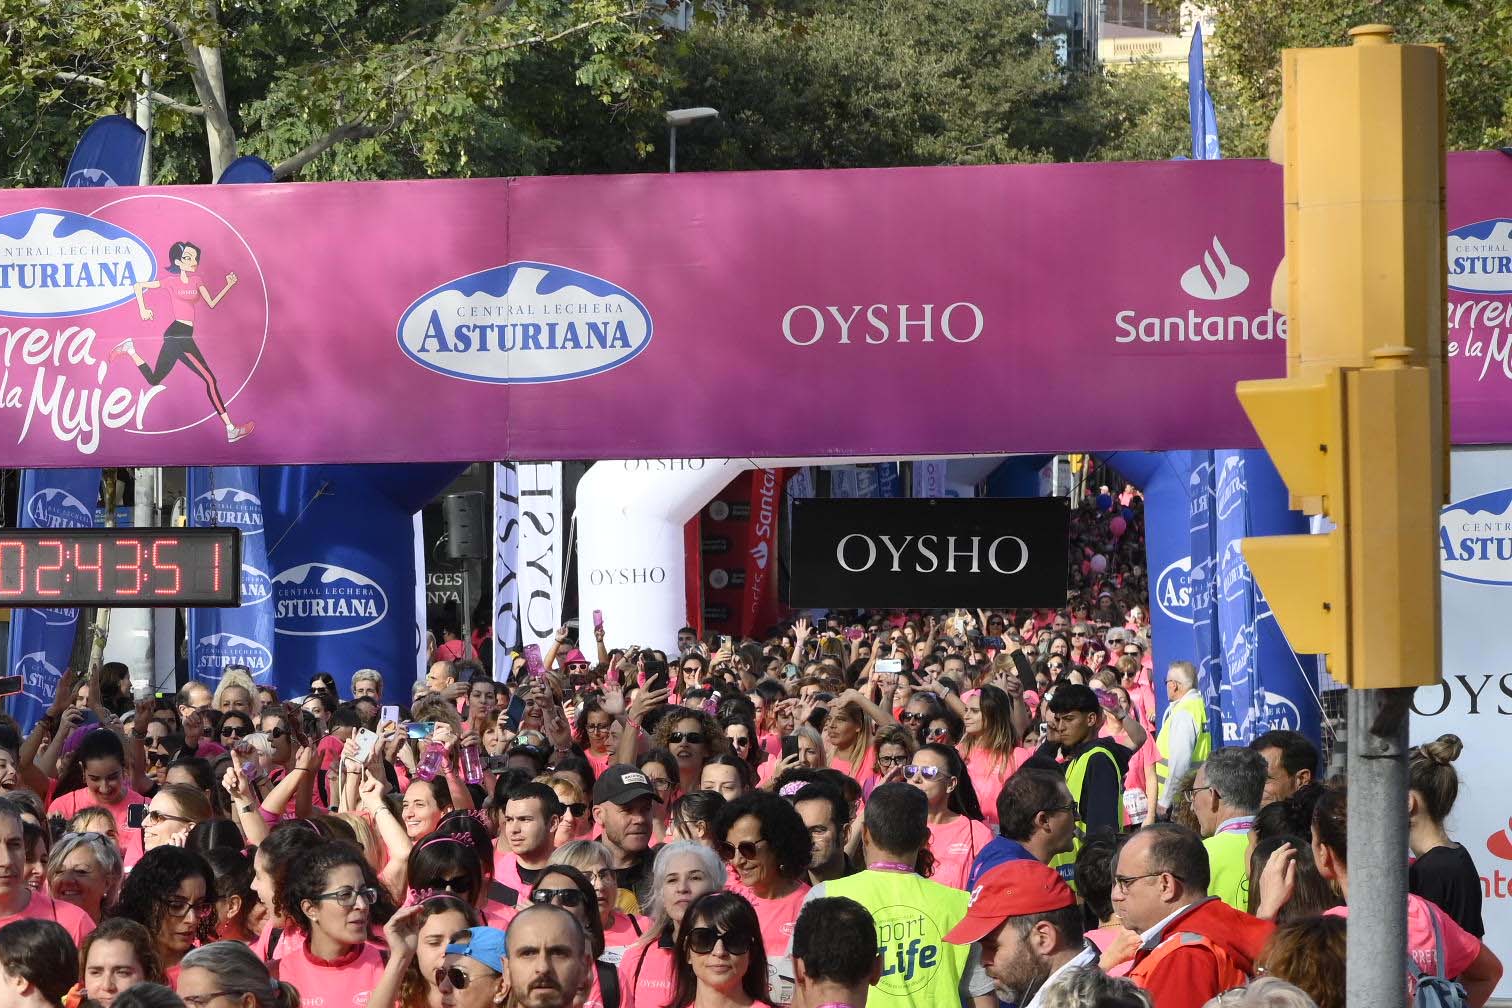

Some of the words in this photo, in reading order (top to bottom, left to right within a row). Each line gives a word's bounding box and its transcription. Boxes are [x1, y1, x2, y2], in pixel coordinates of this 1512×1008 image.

[60, 245, 131, 256] LECHERA
[1456, 244, 1507, 253] CENTRAL
[1448, 255, 1512, 275] STUR
[456, 304, 535, 318] CENTRAL
[543, 302, 624, 316] LECHERA
[418, 308, 633, 354] ASTURIANA
[782, 302, 984, 346] OYSHO
[1465, 330, 1483, 357] la
[18, 360, 167, 454] Mujer
[836, 533, 1029, 574] OYSHO
[590, 566, 666, 585] OYSHO
[278, 587, 321, 597] CENTRAL
[325, 586, 374, 597] LECHERA
[274, 598, 379, 619] STURIANA
[877, 938, 937, 981] Life
